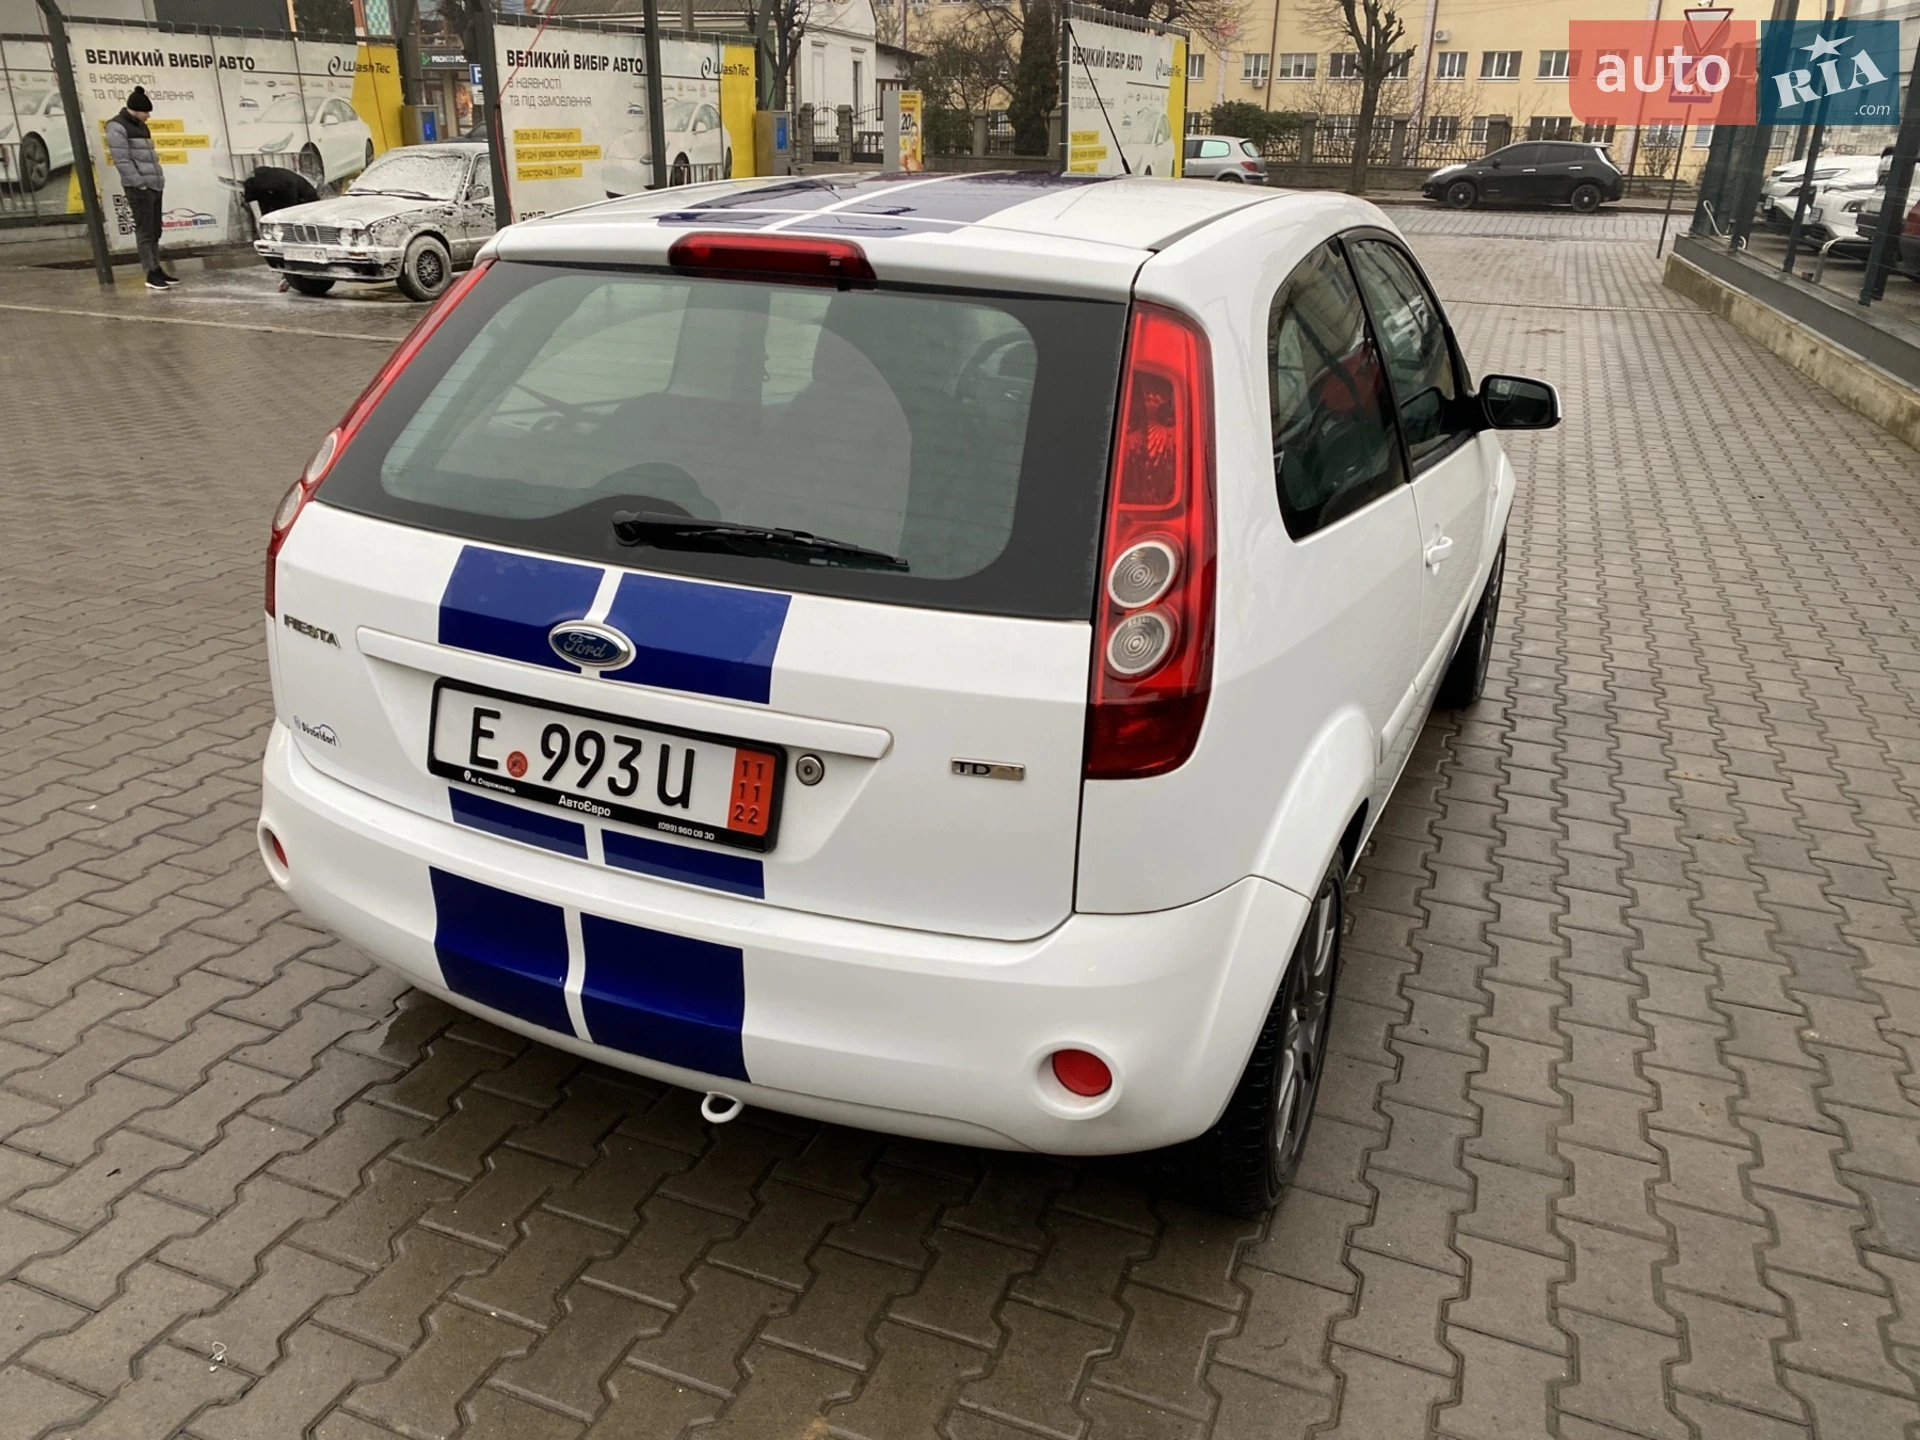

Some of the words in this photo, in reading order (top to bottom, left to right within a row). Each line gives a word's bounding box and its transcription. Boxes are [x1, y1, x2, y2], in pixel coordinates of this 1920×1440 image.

[85, 48, 165, 67] ВЕЛИКИЙ
[168, 53, 214, 69] ВИБІР
[218, 56, 256, 71] АВТО
[343, 61, 391, 75] WashTec
[431, 55, 455, 63] PRONTO
[506, 49, 570, 70] ВЕЛИКИЙ
[573, 54, 609, 72] ВИБІР
[612, 57, 644, 74] АВТО
[713, 62, 750, 77] WashTec
[1072, 45, 1106, 69] ВЕЛИКИЙ
[1106, 50, 1126, 70] ВИБІР
[1126, 53, 1143, 73] АВТО
[89, 73, 97, 83] в
[99, 73, 156, 86] наявності
[516, 77, 561, 91] наявності
[92, 88, 106, 101] та
[107, 88, 127, 102] під
[509, 94, 520, 107] та
[521, 93, 537, 109] під
[537, 95, 593, 109] замовлення
[563, 632, 608, 658] Ford
[470, 707, 501, 770] E
[558, 794, 611, 817] АвтоЄвро
[732, 802, 760, 826] 22
[658, 821, 677, 833] (099)
[677, 825, 693, 837] 960
[693, 829, 703, 839] 09
[704, 831, 715, 842] 30
